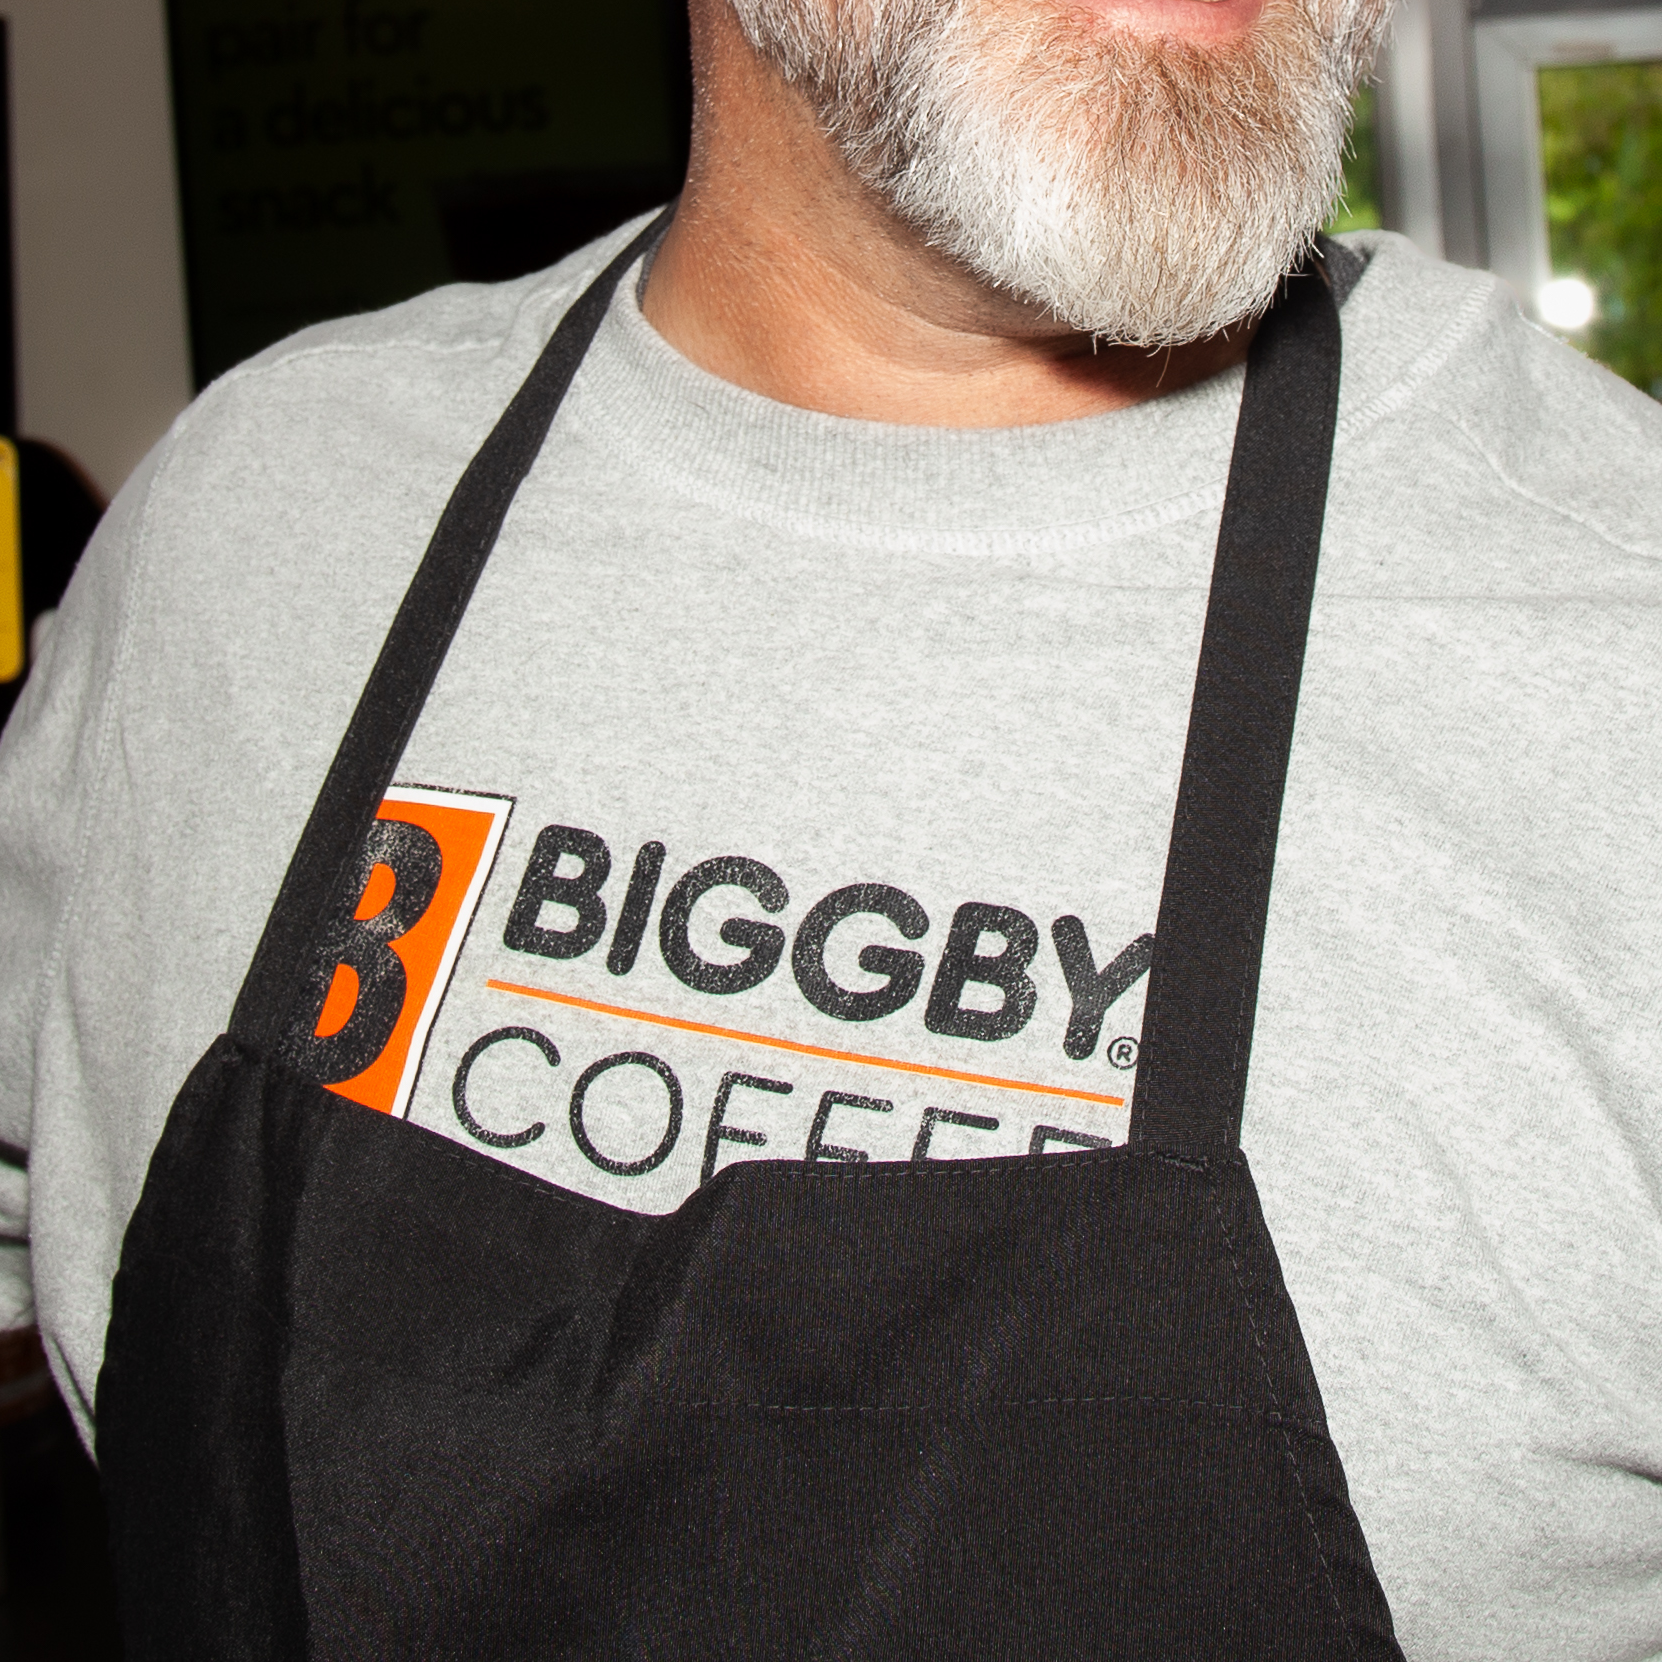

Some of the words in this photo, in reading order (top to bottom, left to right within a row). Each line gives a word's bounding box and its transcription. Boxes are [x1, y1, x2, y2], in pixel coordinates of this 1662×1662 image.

[205, 1, 324, 81] pair
[211, 105, 247, 152] a
[263, 75, 551, 149] delicious
[217, 161, 402, 235] snack
